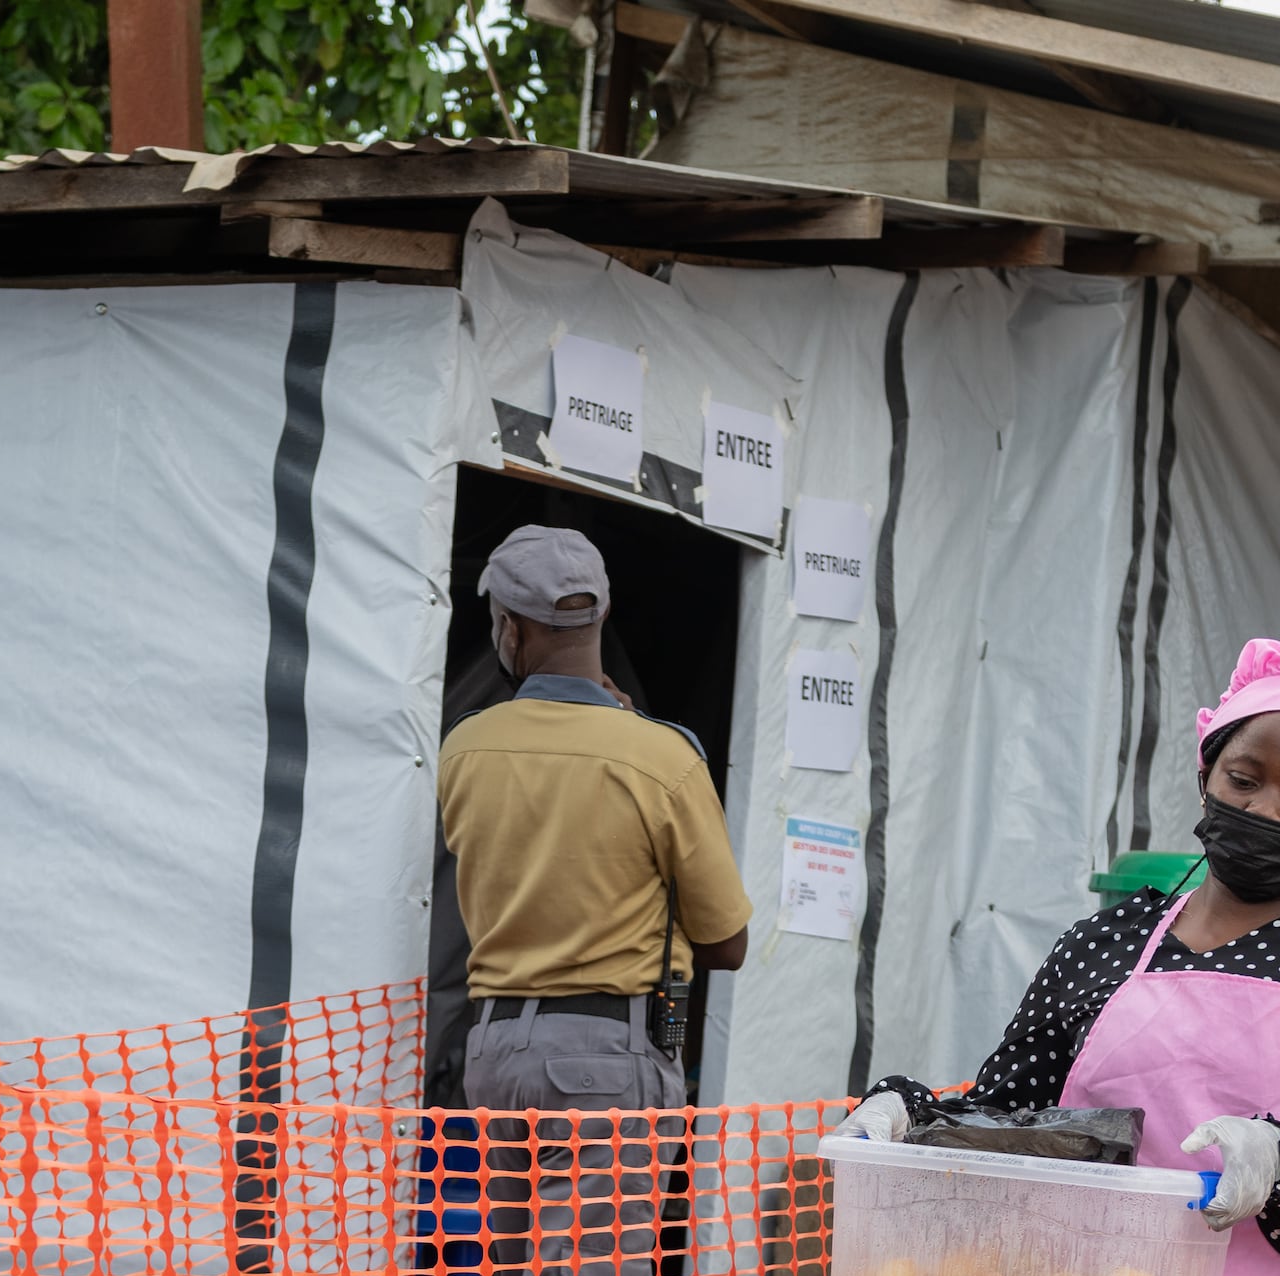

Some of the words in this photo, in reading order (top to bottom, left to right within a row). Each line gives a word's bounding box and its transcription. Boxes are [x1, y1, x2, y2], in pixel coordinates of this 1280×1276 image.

[568, 396, 633, 433] PRETRIAGE
[716, 430, 773, 469] ENTREE
[805, 551, 862, 578] PRETRIAGE
[801, 675, 854, 706] ENTREE
